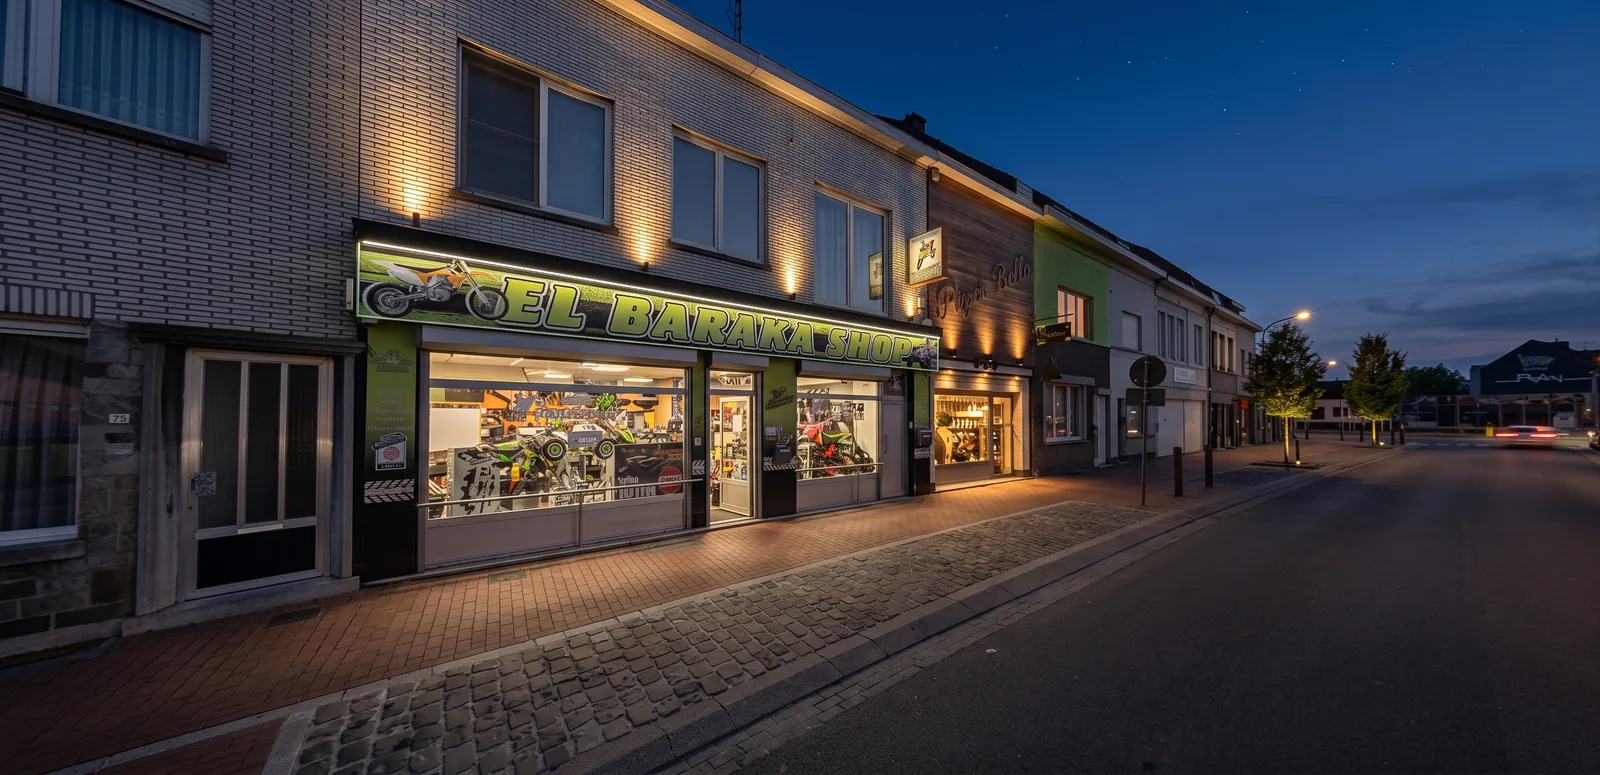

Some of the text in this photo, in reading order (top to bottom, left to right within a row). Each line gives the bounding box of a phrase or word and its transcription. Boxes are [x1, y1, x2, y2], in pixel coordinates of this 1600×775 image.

[496, 275, 914, 365] EL BARAKA SHOP
